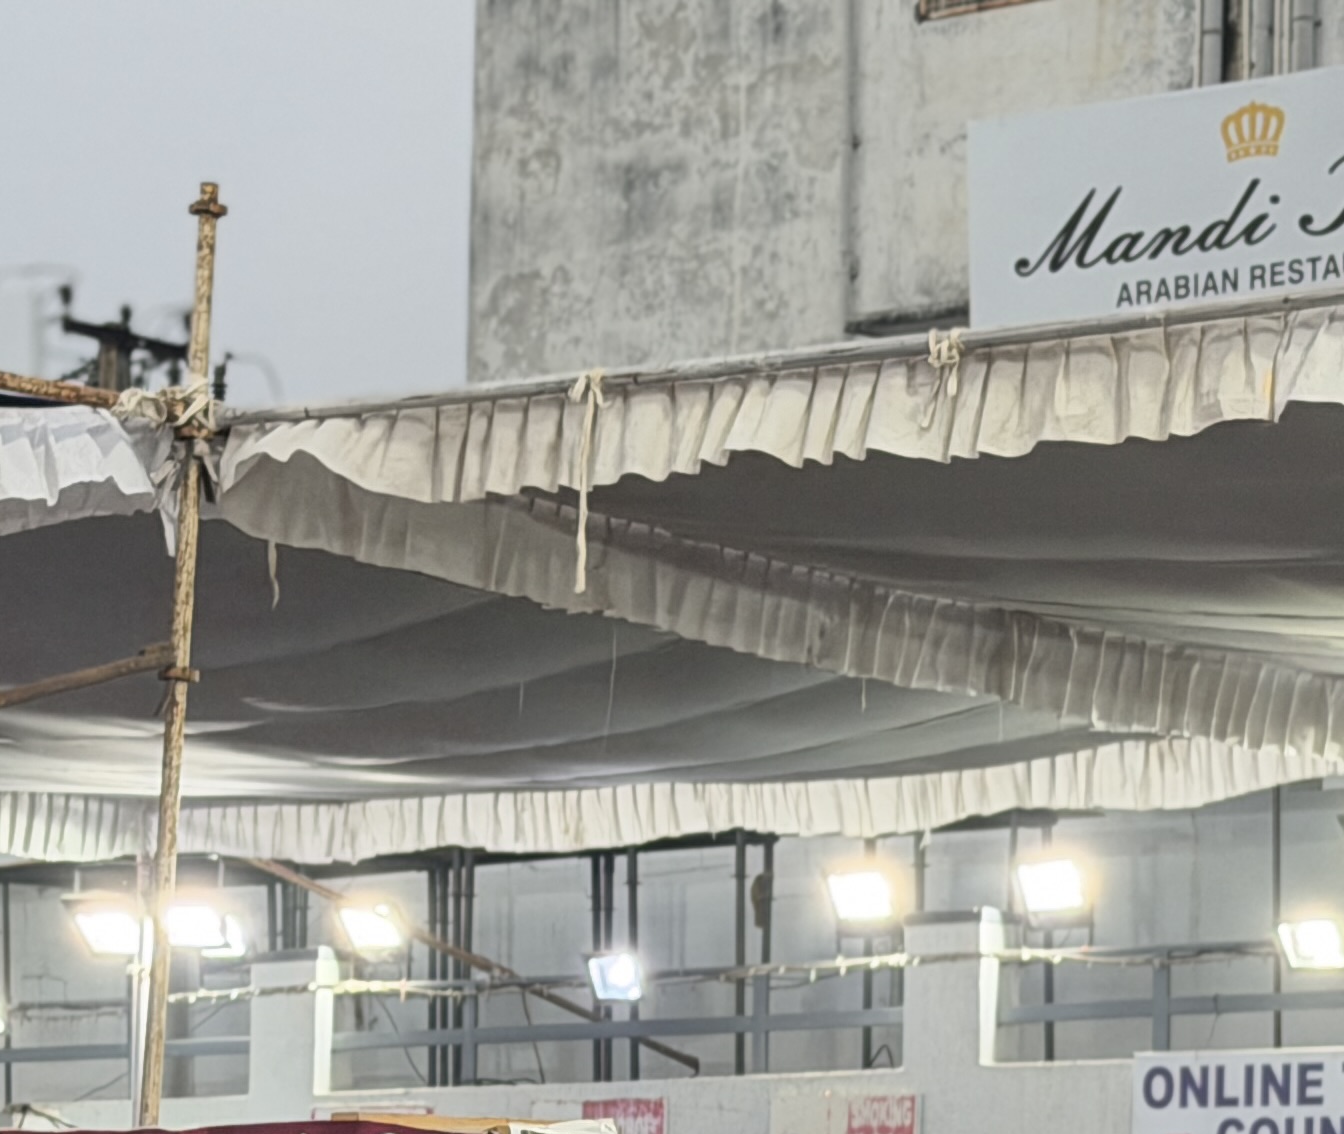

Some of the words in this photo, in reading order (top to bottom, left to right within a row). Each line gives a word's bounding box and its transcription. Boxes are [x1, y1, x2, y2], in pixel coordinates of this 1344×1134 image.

[1013, 178, 1281, 277] Mandi
[1115, 268, 1239, 309] ARABIAN
[1142, 1062, 1325, 1109] ONLINE
